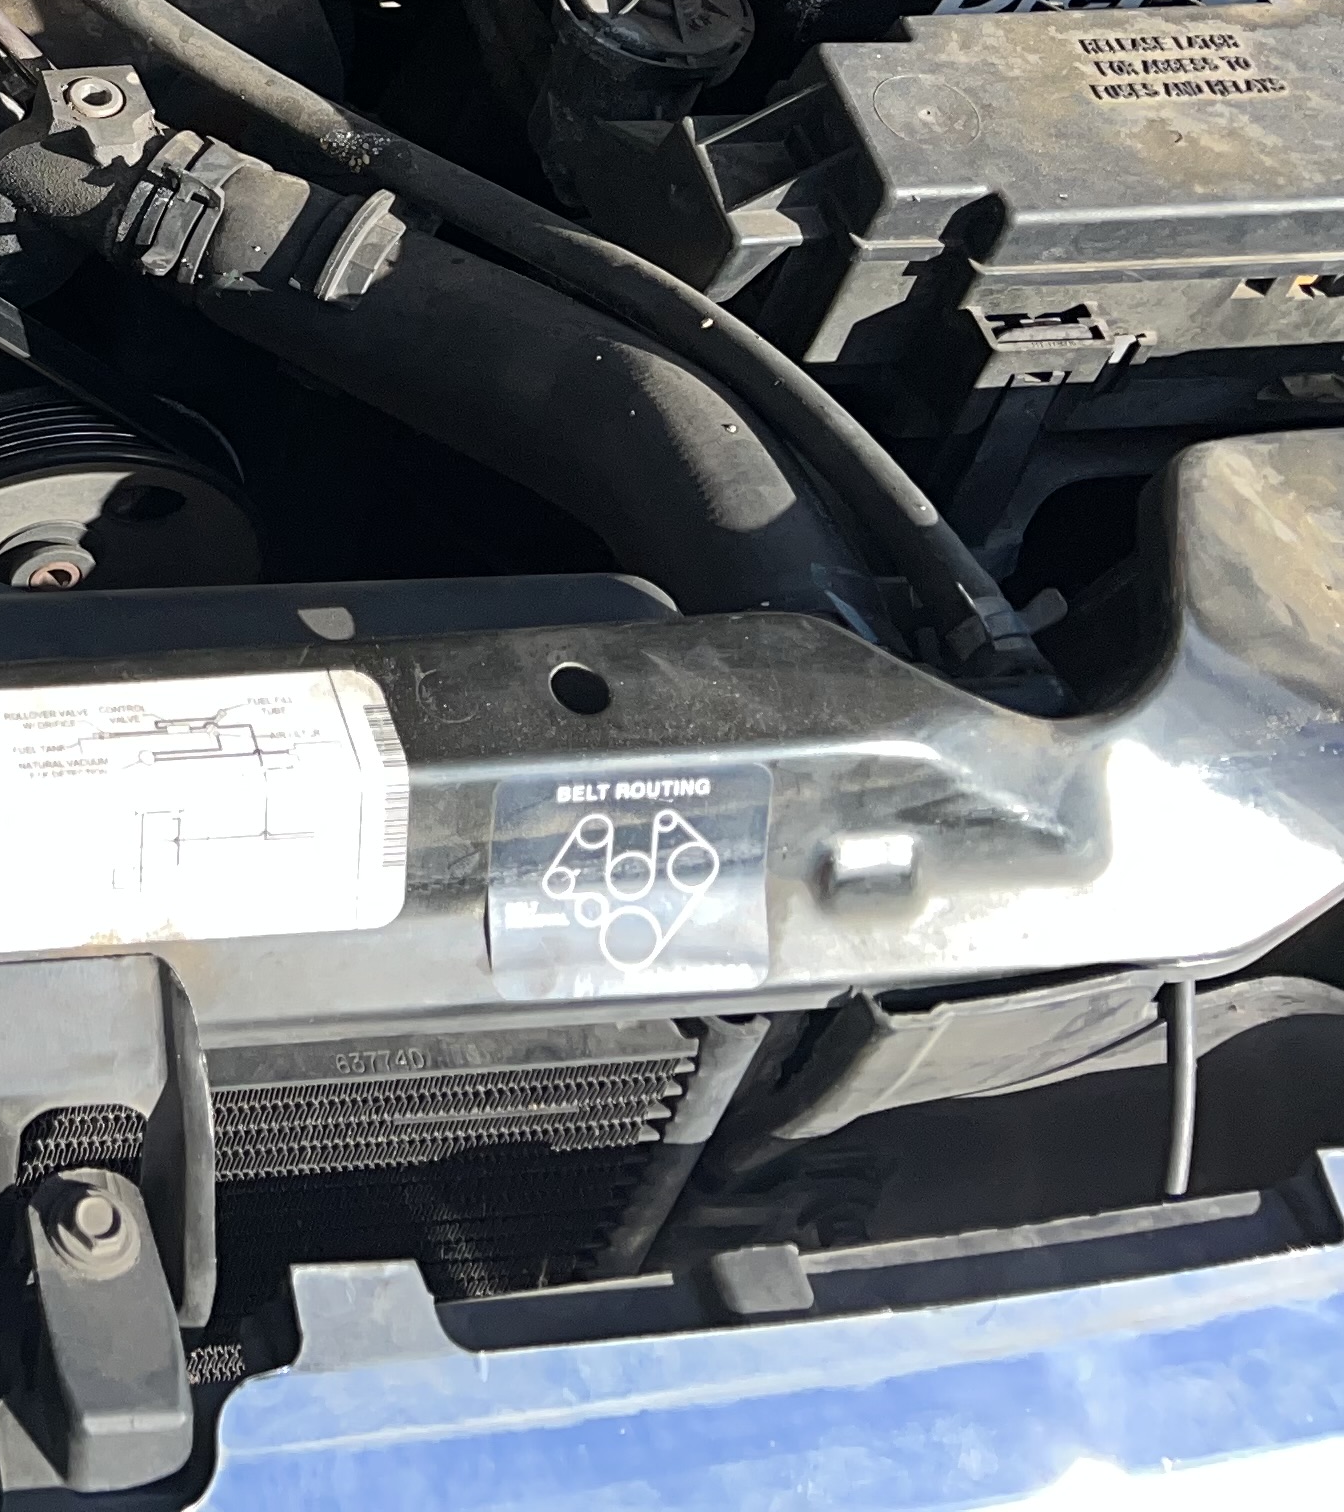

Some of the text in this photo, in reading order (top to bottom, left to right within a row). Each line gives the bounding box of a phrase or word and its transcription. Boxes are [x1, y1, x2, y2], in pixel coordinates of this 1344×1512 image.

[1078, 34, 1240, 54] RELEASE LATCH
[1093, 56, 1253, 76] FOR ACCESS TO
[1089, 77, 1288, 100] FUSES AND RELAYS
[556, 777, 711, 804] BELT ROUTING
